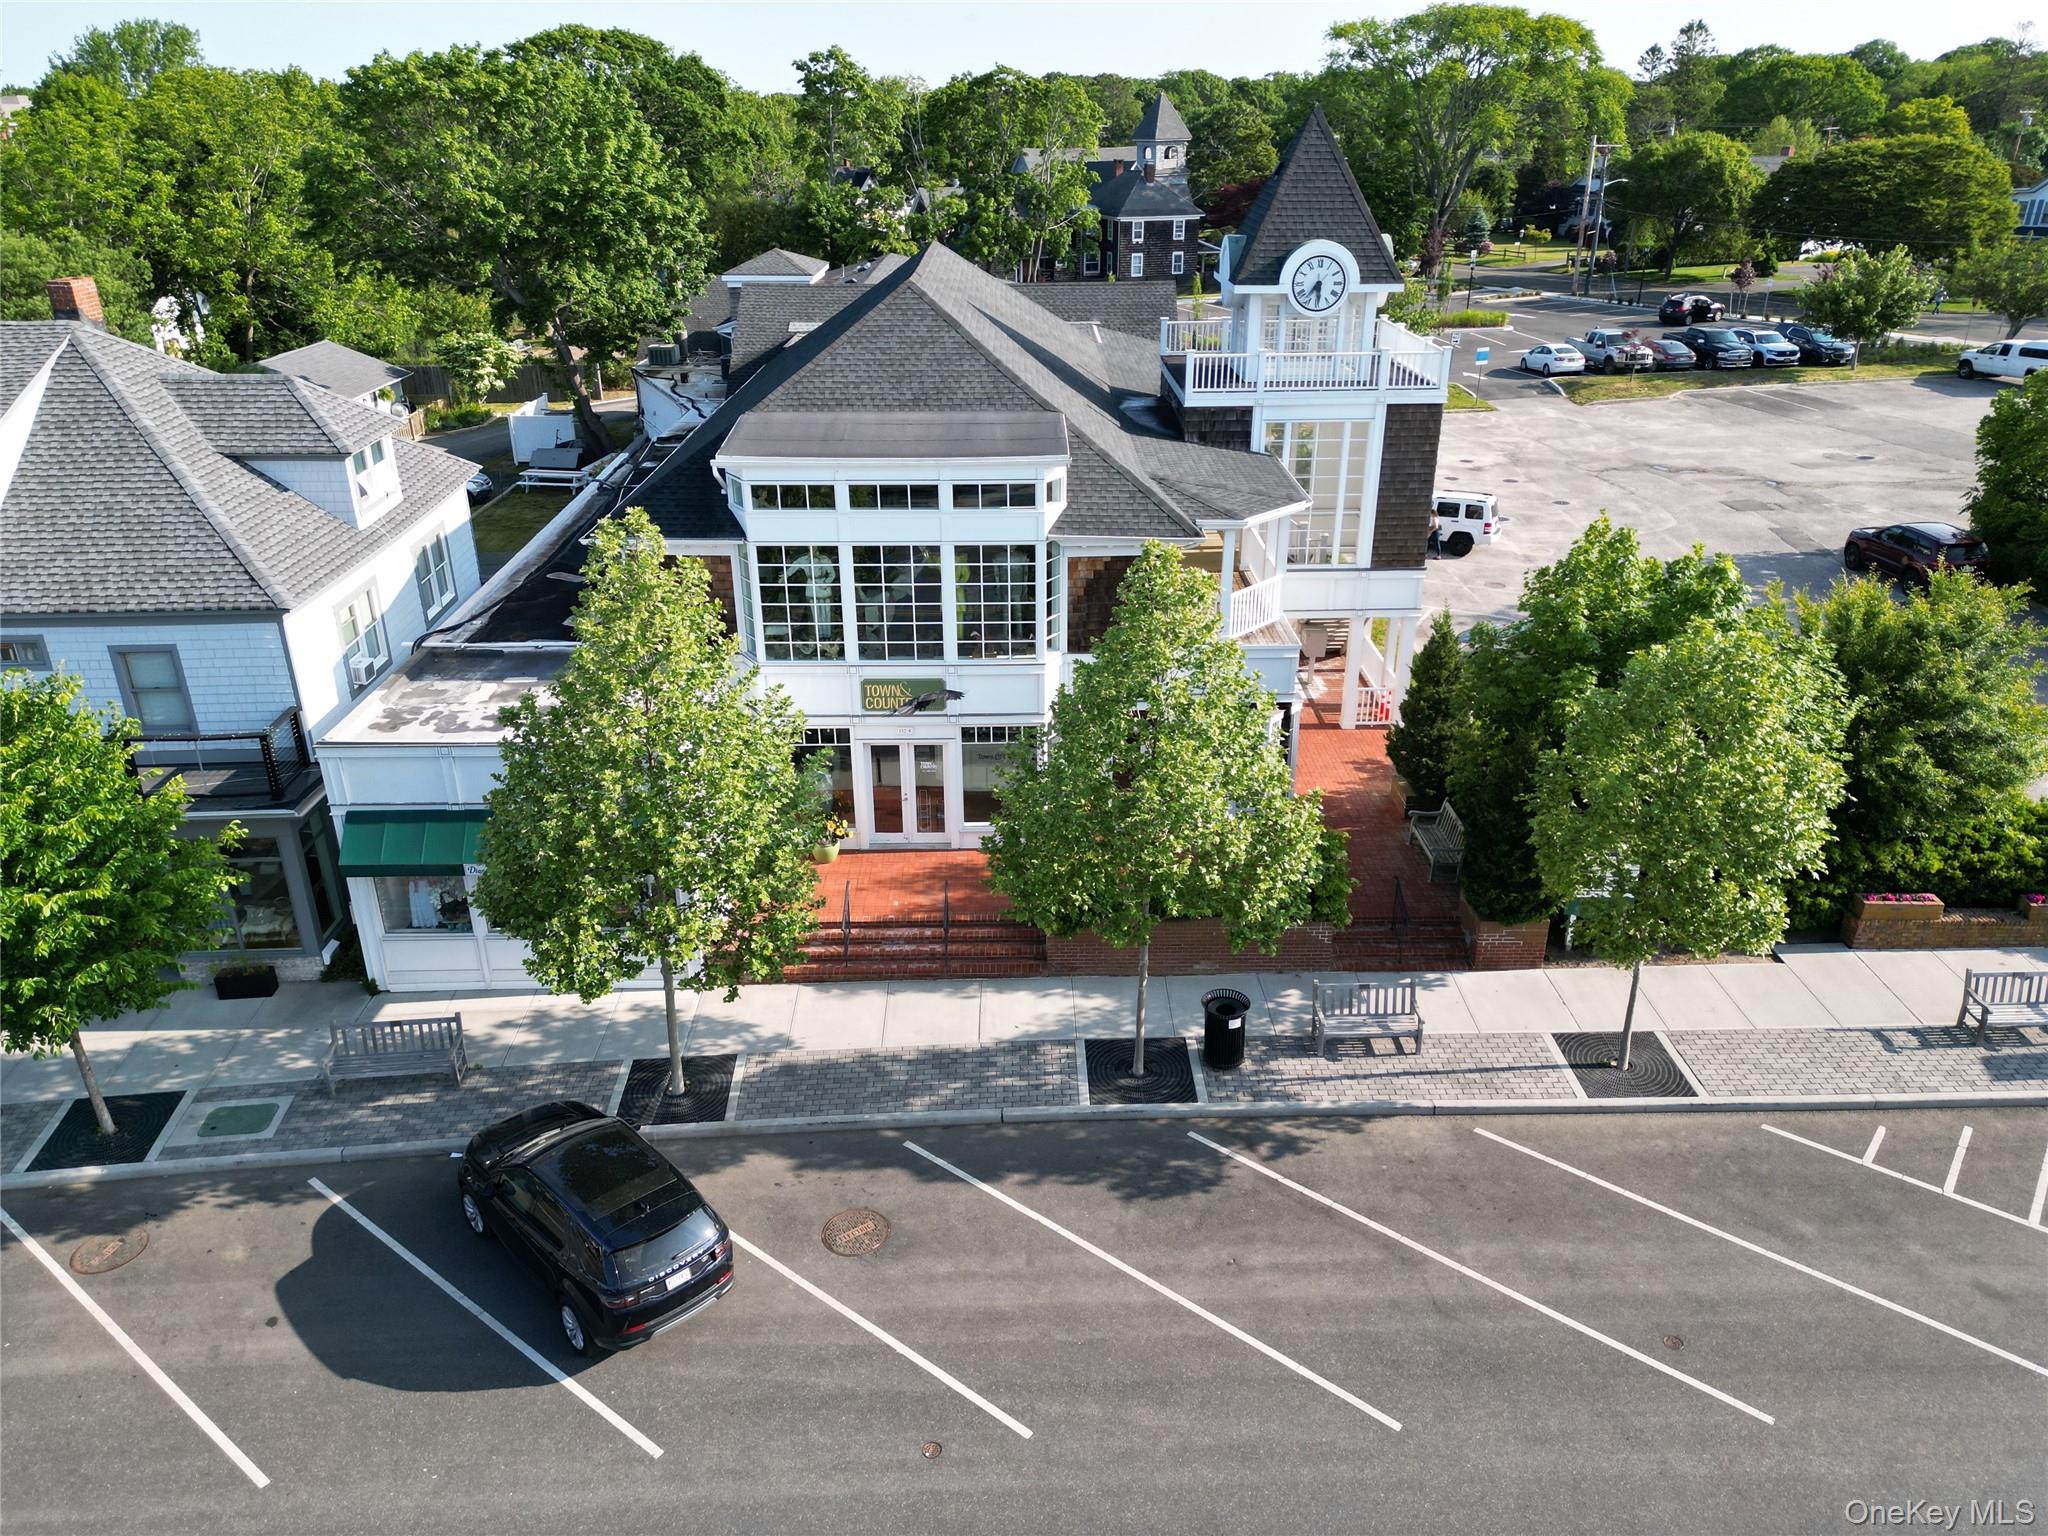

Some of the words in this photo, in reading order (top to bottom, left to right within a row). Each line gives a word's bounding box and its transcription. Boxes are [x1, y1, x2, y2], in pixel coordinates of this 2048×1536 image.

[864, 684, 900, 697] TOWN
[899, 681, 913, 698] &
[865, 697, 913, 710] COUNT
[648, 1248, 704, 1283] DISCOVERY
